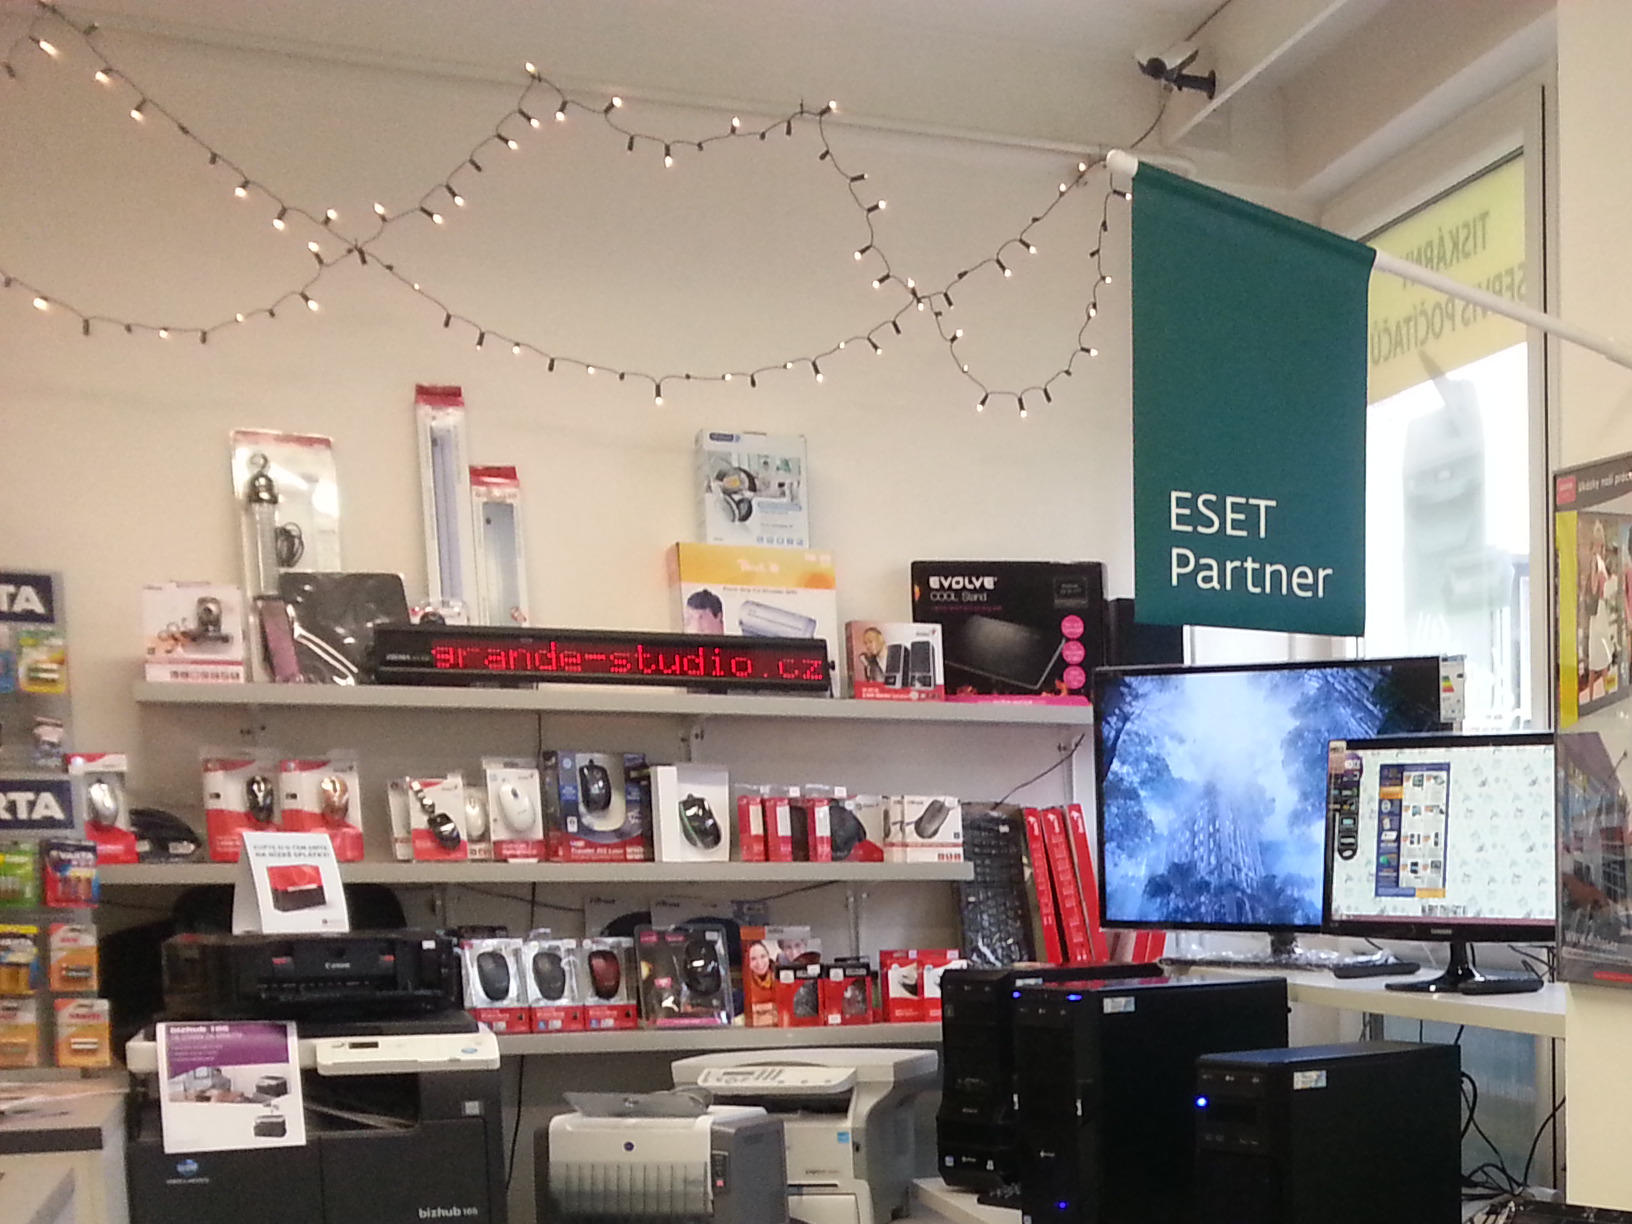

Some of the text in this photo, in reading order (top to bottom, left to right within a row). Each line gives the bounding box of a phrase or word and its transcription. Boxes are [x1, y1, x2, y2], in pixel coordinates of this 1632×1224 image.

[1170, 490, 1277, 539] ESET
[929, 576, 995, 590] EVOLVE
[1170, 546, 1334, 599] Partner
[930, 591, 988, 602] COOL Stand
[431, 640, 823, 681] grande-studio.cz
[418, 1206, 461, 1219] bizhub
